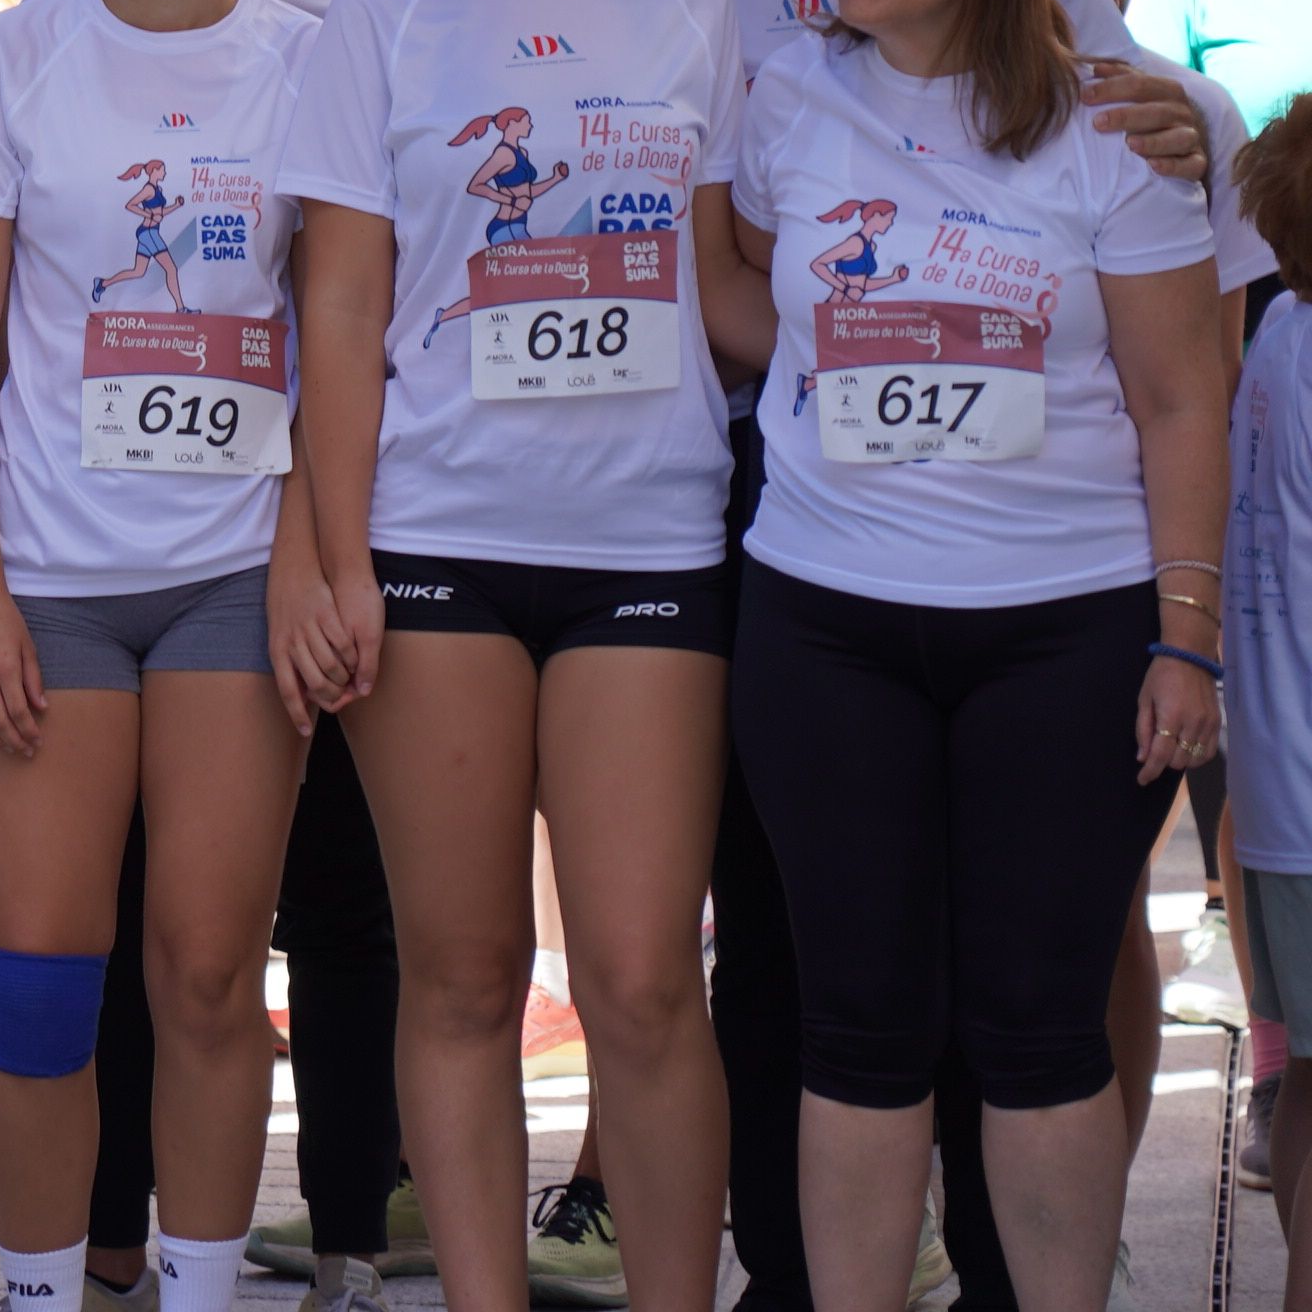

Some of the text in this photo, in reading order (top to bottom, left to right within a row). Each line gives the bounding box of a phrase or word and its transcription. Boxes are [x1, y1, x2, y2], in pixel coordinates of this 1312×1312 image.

[512, 34, 575, 59] ADA
[575, 96, 625, 110] MORA
[159, 113, 195, 128] ADA
[629, 121, 681, 144] Cursa
[191, 156, 219, 165] MORA
[582, 146, 680, 172] de la Dona
[218, 174, 251, 188] Cursa
[191, 189, 249, 203] de la Dona
[600, 193, 673, 215] CADA
[201, 215, 245, 228] CADA
[941, 208, 988, 227] MORA
[201, 229, 246, 244] PAS
[202, 247, 246, 261] SUMA
[485, 244, 527, 258] MORA
[623, 240, 659, 254] CADA
[624, 253, 660, 268] PAS
[978, 246, 1040, 278] Cursa
[626, 268, 659, 282] SUMA
[922, 263, 1032, 304] de la Dona
[833, 308, 878, 322] MORA
[980, 312, 1021, 324] CADA
[104, 317, 146, 330] MORA
[981, 324, 1022, 337] PAS
[242, 327, 270, 340] CADA
[527, 306, 629, 361] 618
[122, 336, 146, 348] Cursa
[148, 338, 159, 348] de
[173, 338, 194, 350] Dona
[241, 339, 270, 354] PAS
[982, 337, 1024, 349] SUMA
[241, 354, 271, 368] SUMA
[878, 375, 986, 433] 617
[139, 385, 239, 447] 619
[382, 582, 455, 600] NIKE
[613, 602, 680, 619] PRO
[8, 1283, 54, 1296] FILA
